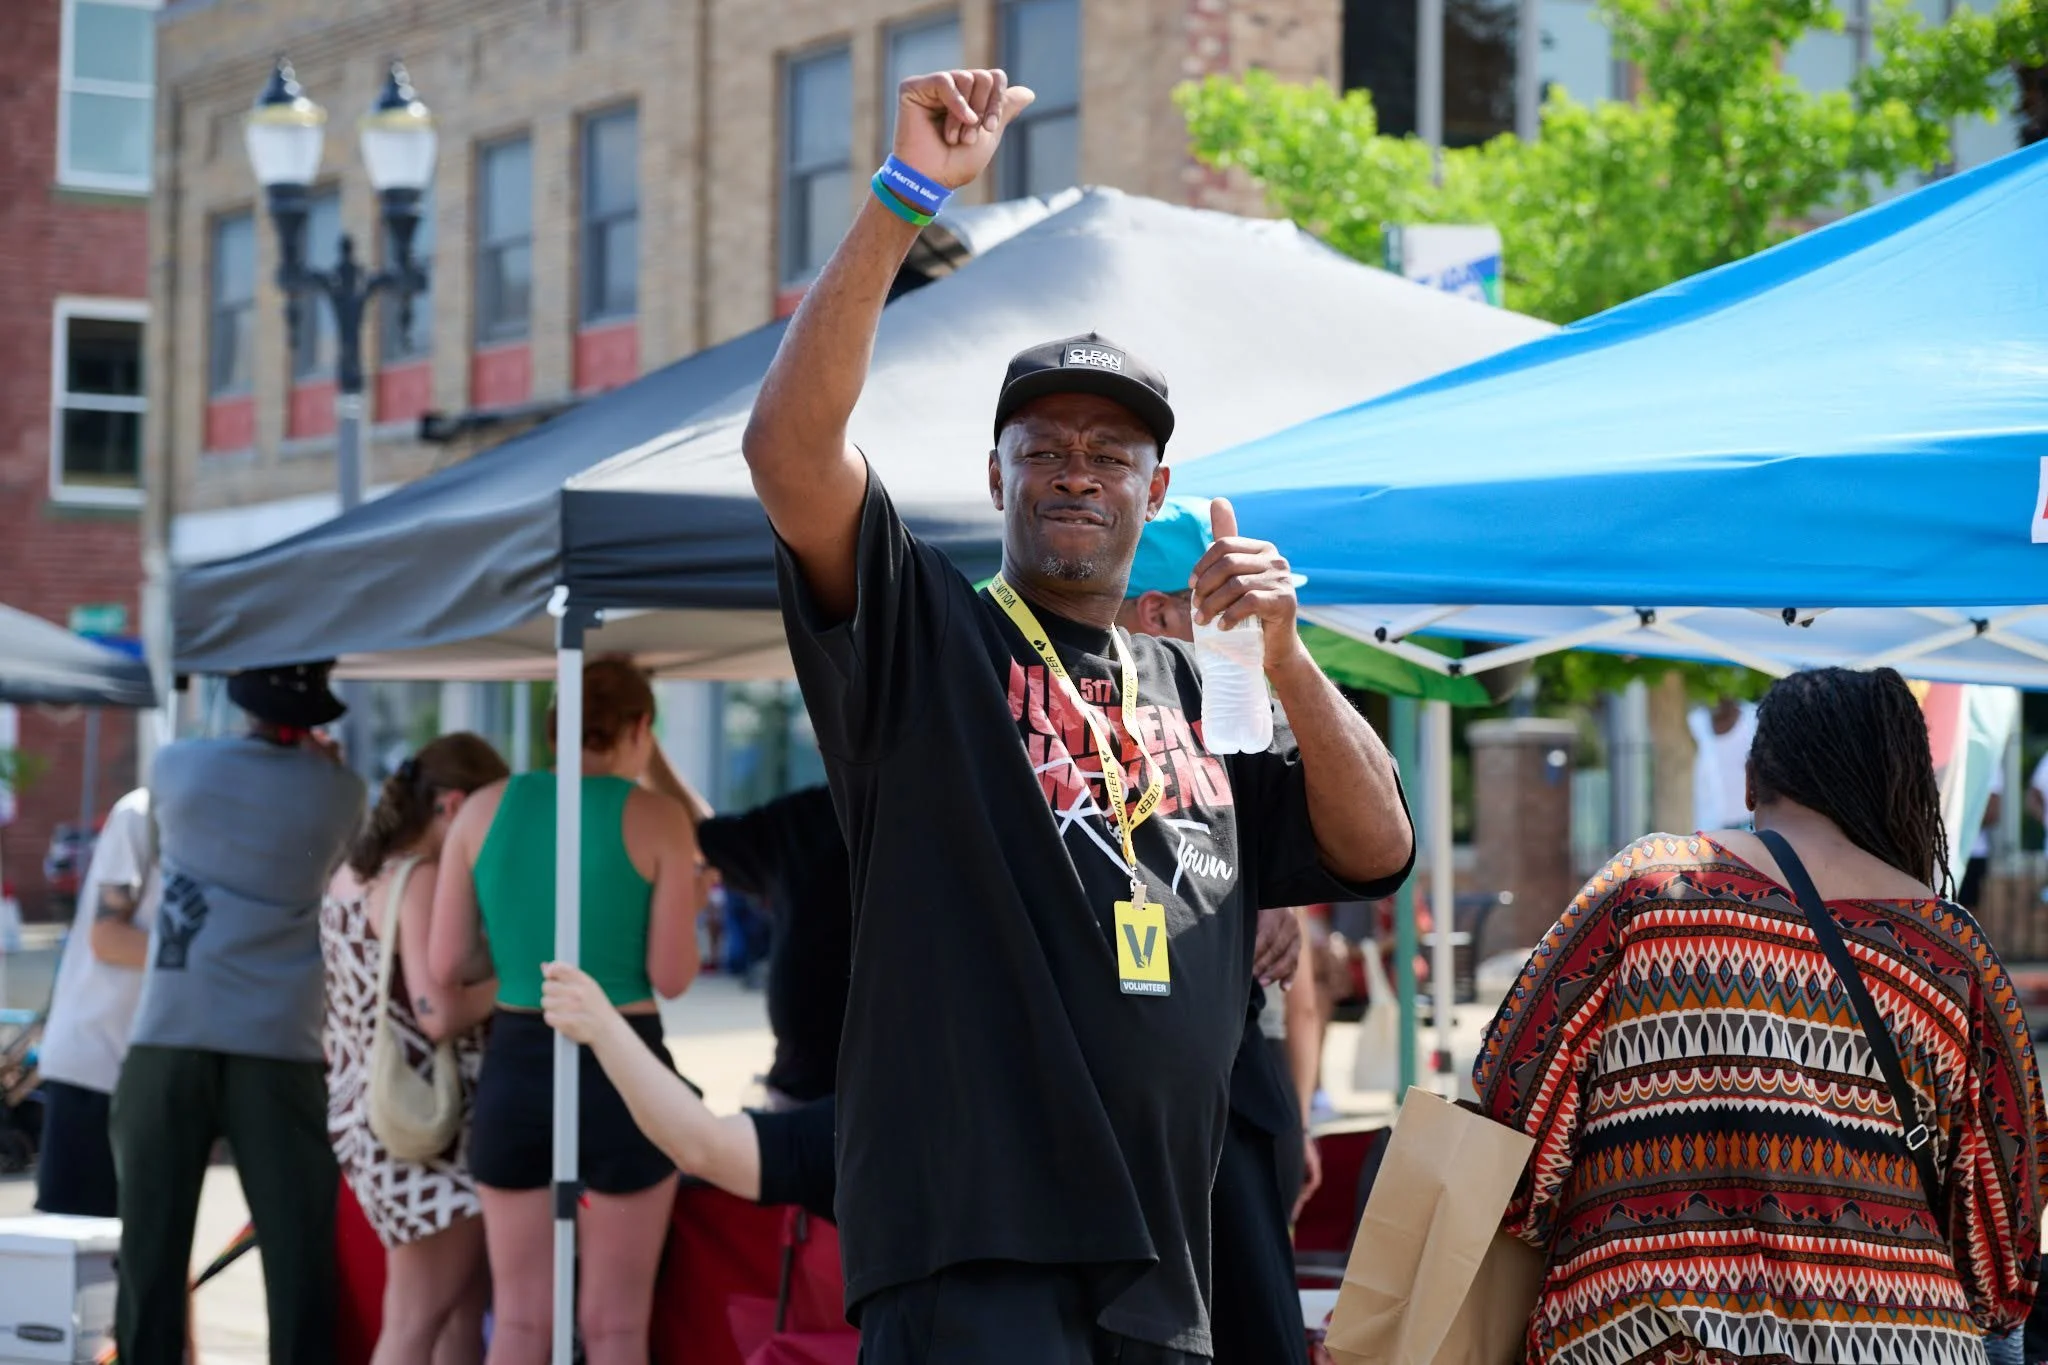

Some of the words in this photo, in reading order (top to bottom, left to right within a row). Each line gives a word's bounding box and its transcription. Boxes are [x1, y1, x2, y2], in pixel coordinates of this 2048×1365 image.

[1070, 348, 1122, 366] CLEAN
[1081, 677, 1113, 704] 517
[1107, 771, 1127, 832] LUNTEER
[1122, 924, 1158, 968] V
[1122, 981, 1167, 993] VOLUNTEER
